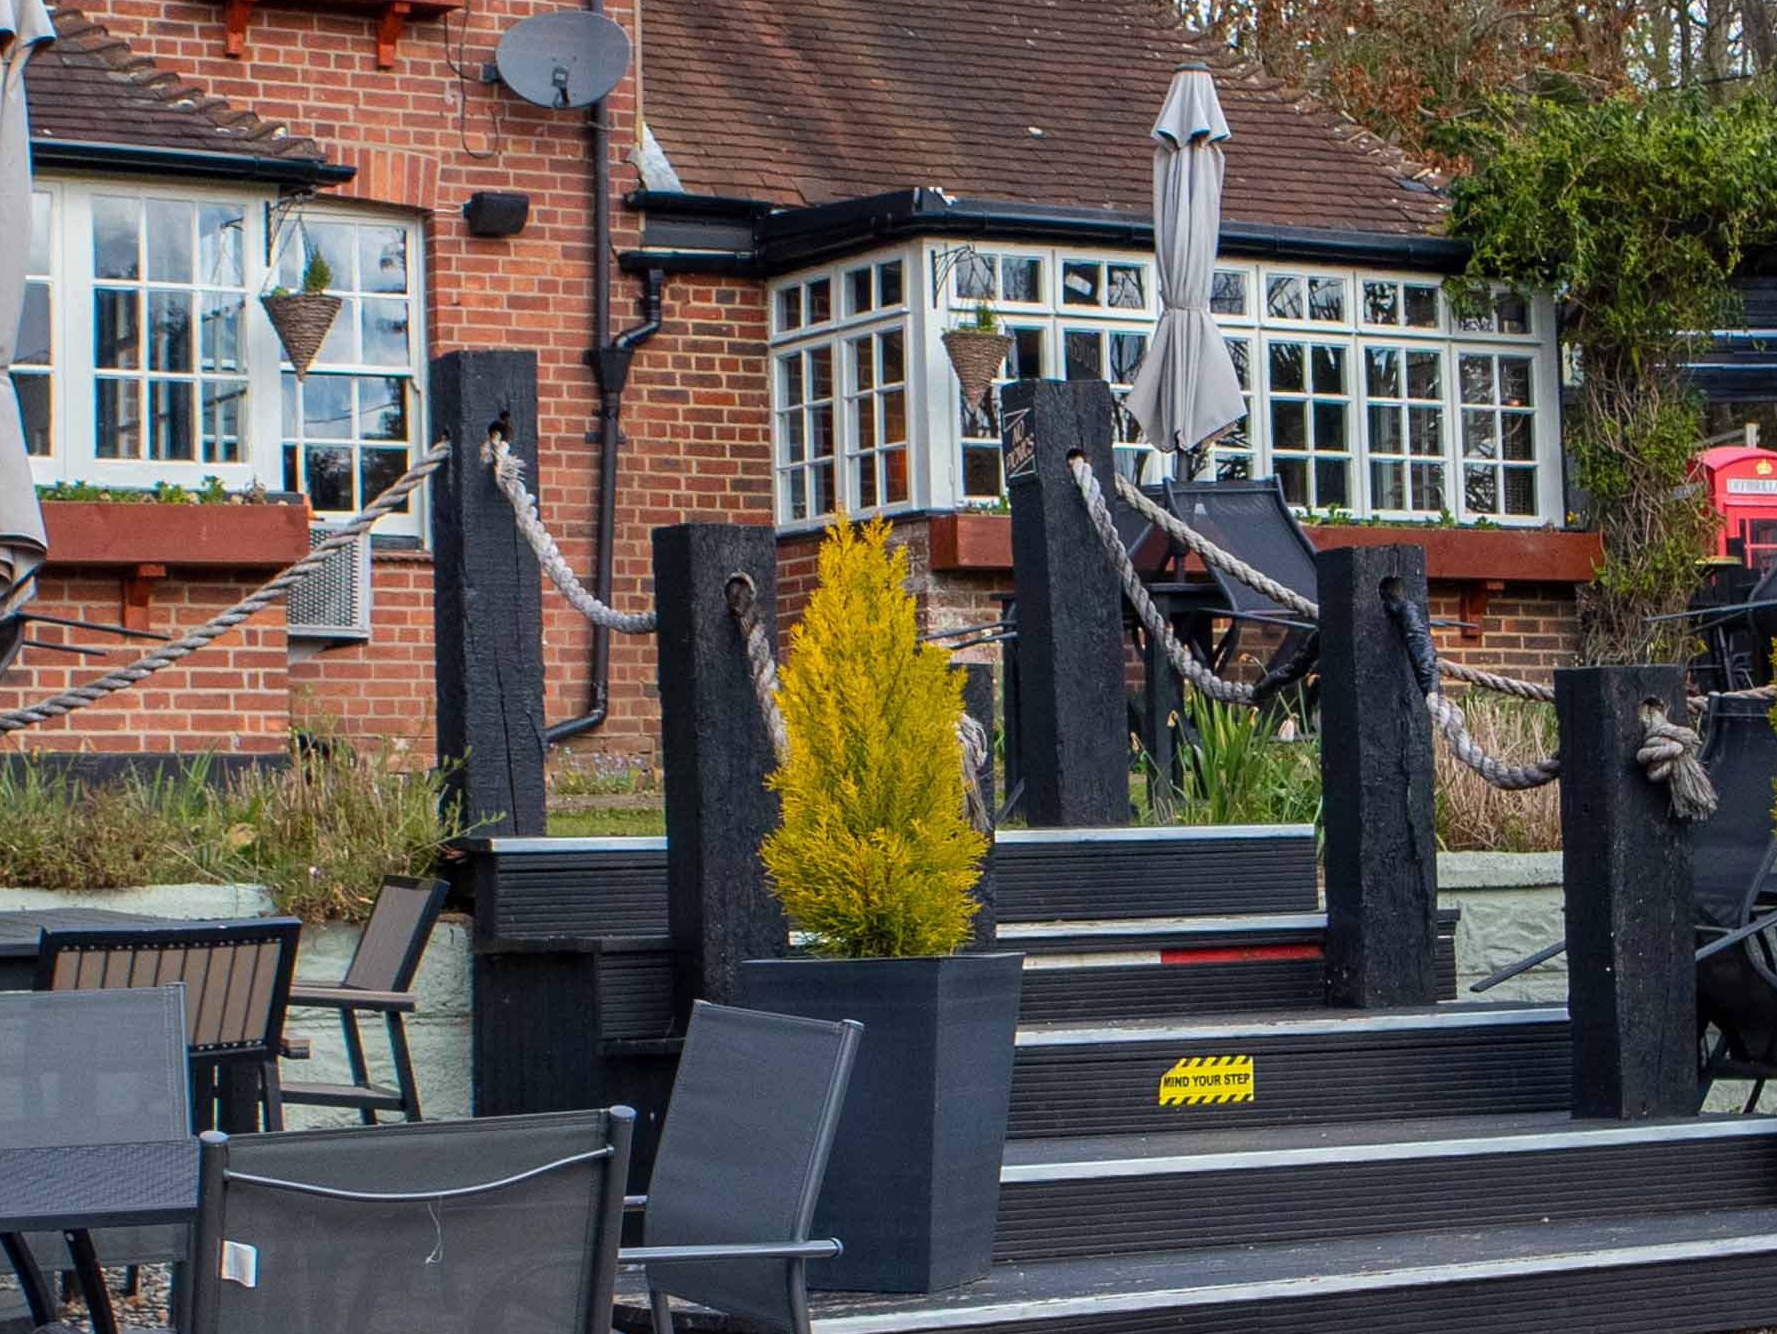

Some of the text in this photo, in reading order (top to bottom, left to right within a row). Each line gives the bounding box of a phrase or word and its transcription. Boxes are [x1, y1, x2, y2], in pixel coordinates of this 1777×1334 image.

[1163, 1072, 1250, 1088] MIND YOUR STEP
